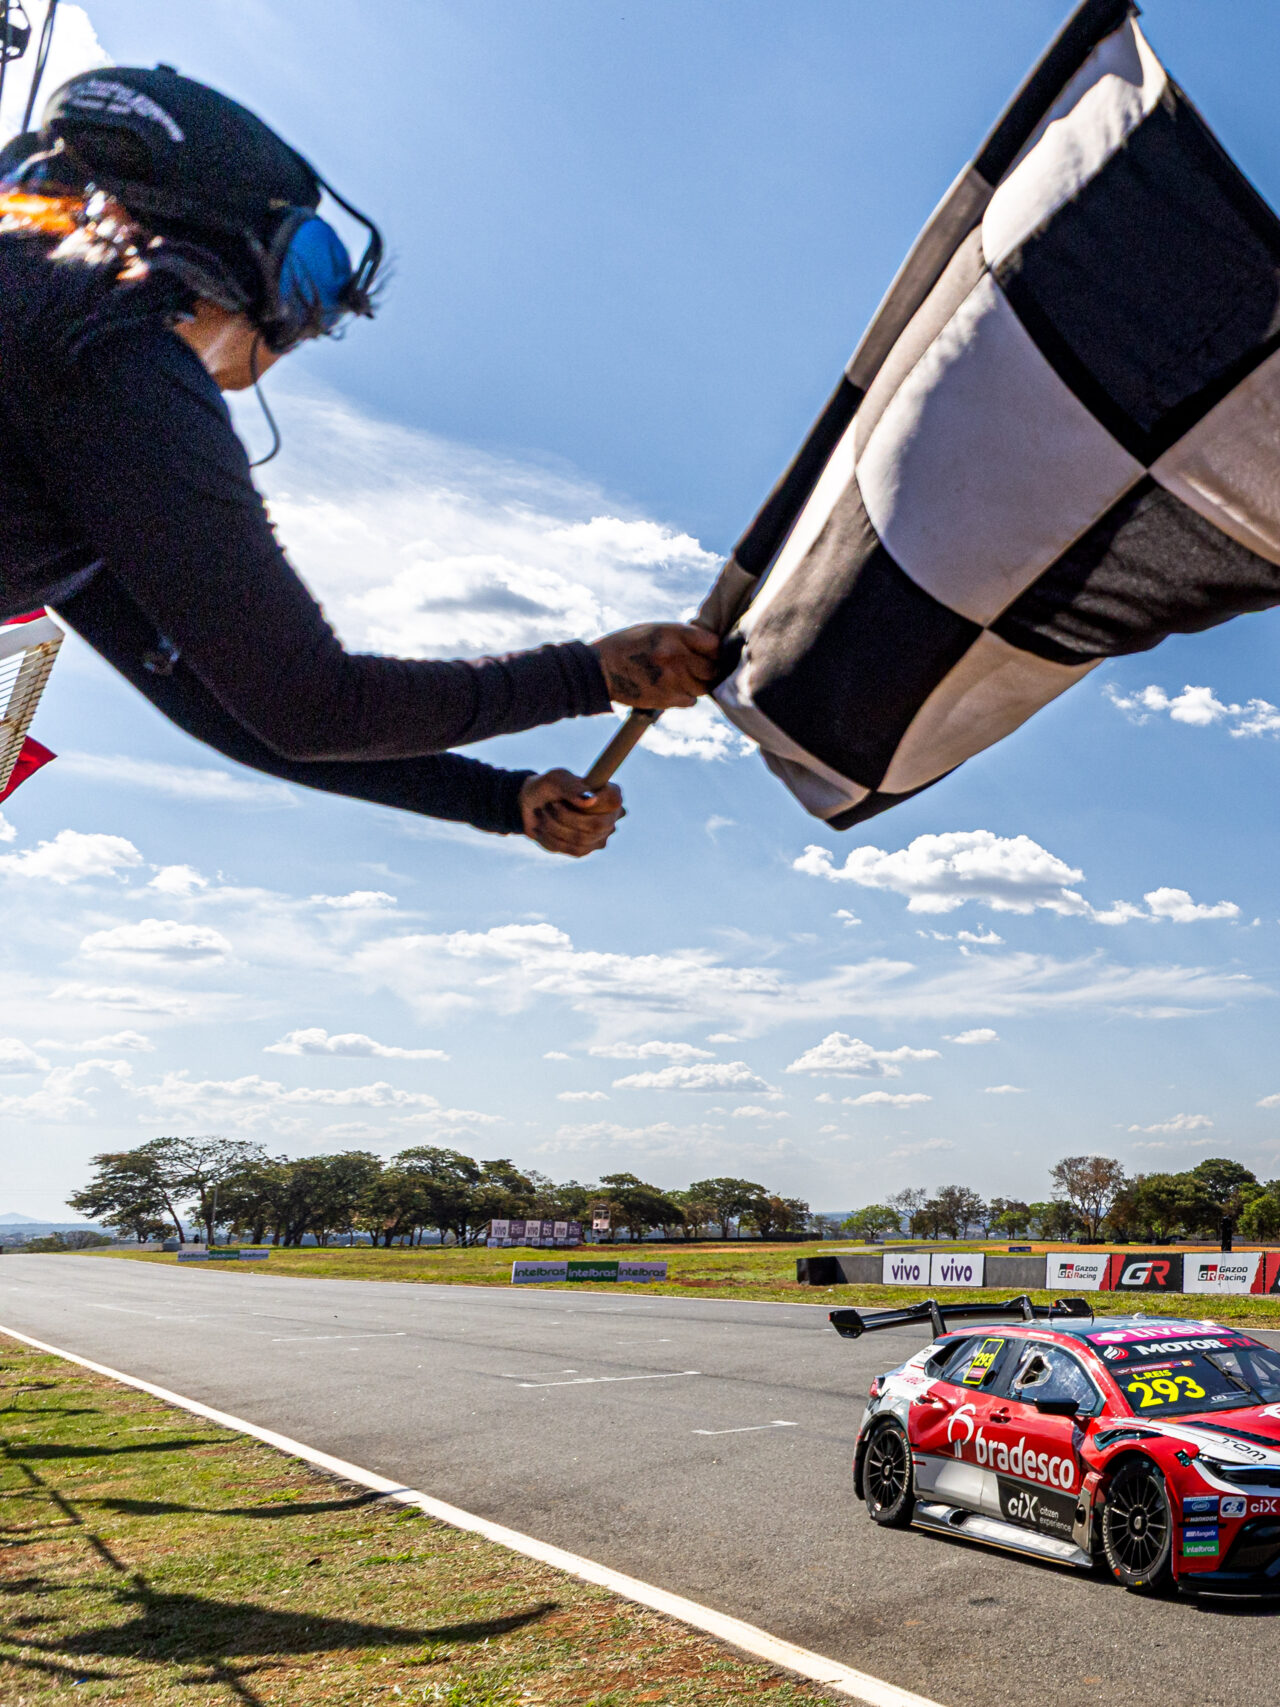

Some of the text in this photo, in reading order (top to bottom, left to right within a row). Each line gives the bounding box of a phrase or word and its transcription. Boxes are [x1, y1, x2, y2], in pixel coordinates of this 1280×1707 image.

[514, 1267, 566, 1277] intelbras
[568, 1268, 617, 1278] intelbras
[619, 1266, 666, 1277] intelbras
[891, 1258, 920, 1281] vivo
[941, 1258, 972, 1282] vivo
[1058, 1269, 1073, 1278] GR
[1121, 1260, 1171, 1286] GR
[1198, 1270, 1217, 1281] GR
[1074, 1272, 1097, 1281] Racing
[1218, 1273, 1247, 1283] Racing
[1127, 1376, 1206, 1408] 293
[975, 1426, 1075, 1489] bradesco
[1007, 1492, 1039, 1522] ciX
[1250, 1499, 1278, 1513] ciX
